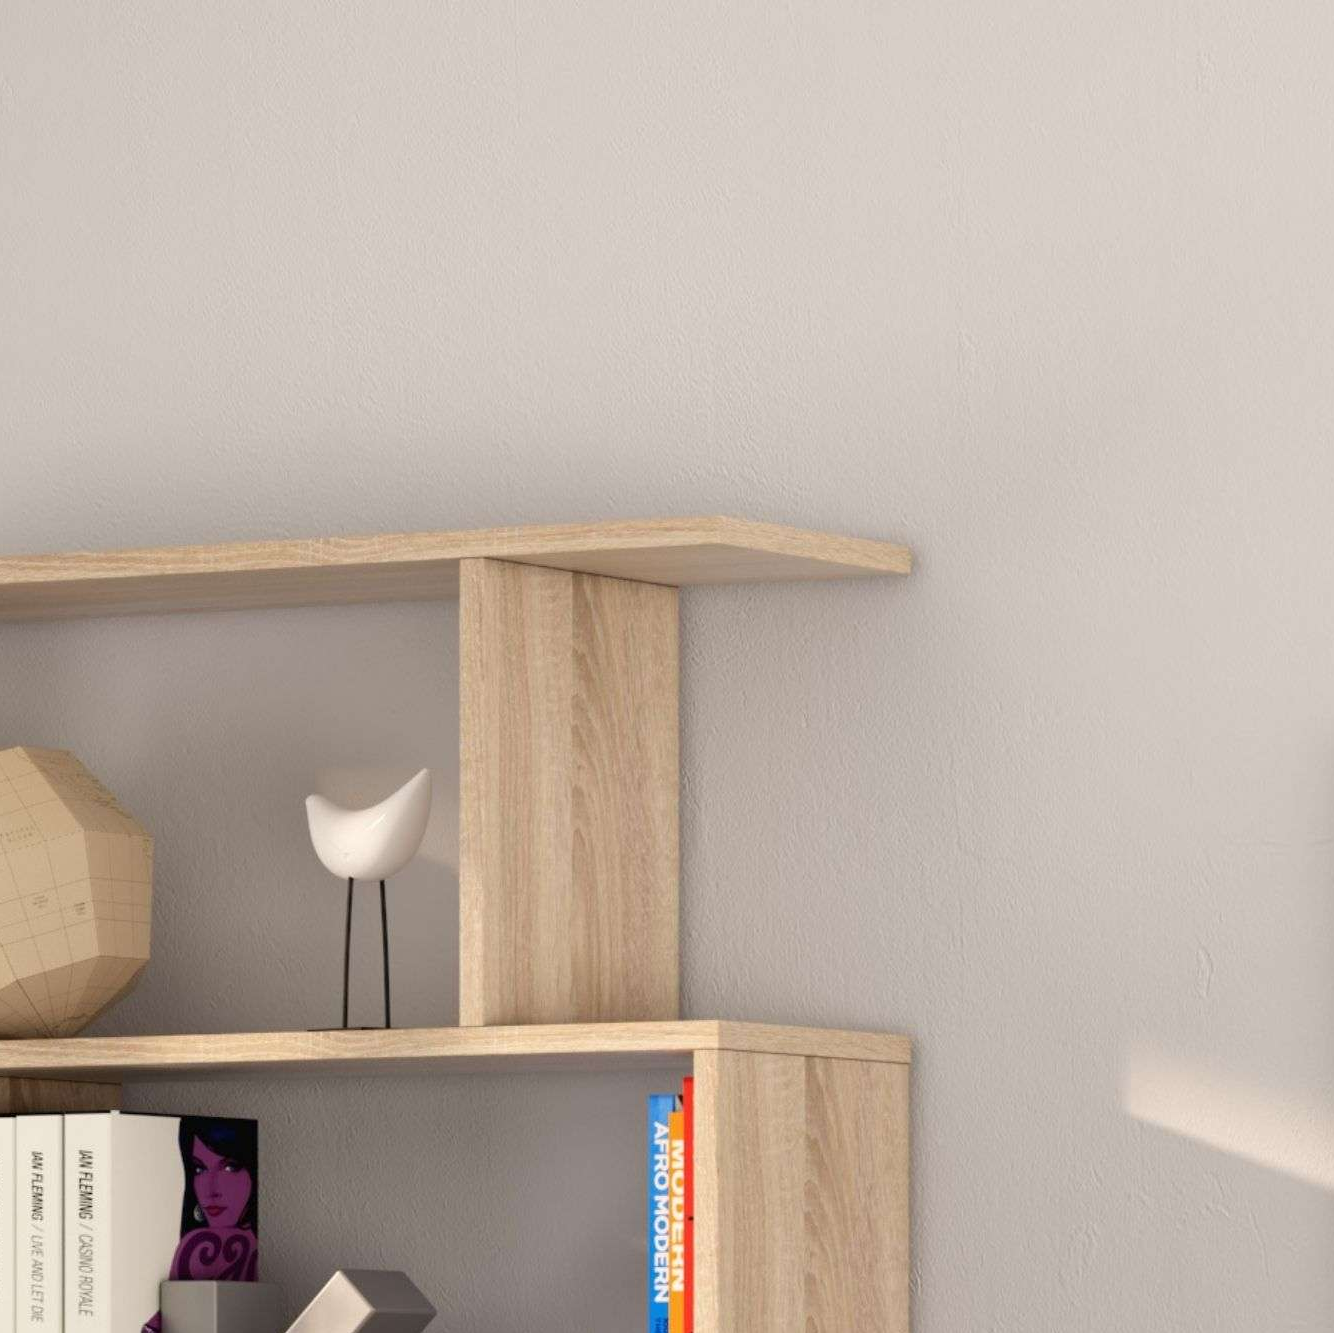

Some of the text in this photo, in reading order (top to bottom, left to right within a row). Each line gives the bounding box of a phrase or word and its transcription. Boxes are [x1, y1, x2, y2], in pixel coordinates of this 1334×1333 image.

[653, 1121, 669, 1191] AFRO
[79, 1150, 94, 1316] IAN FLEMING CASINO ROYALE
[653, 1195, 669, 1303] MODERN
